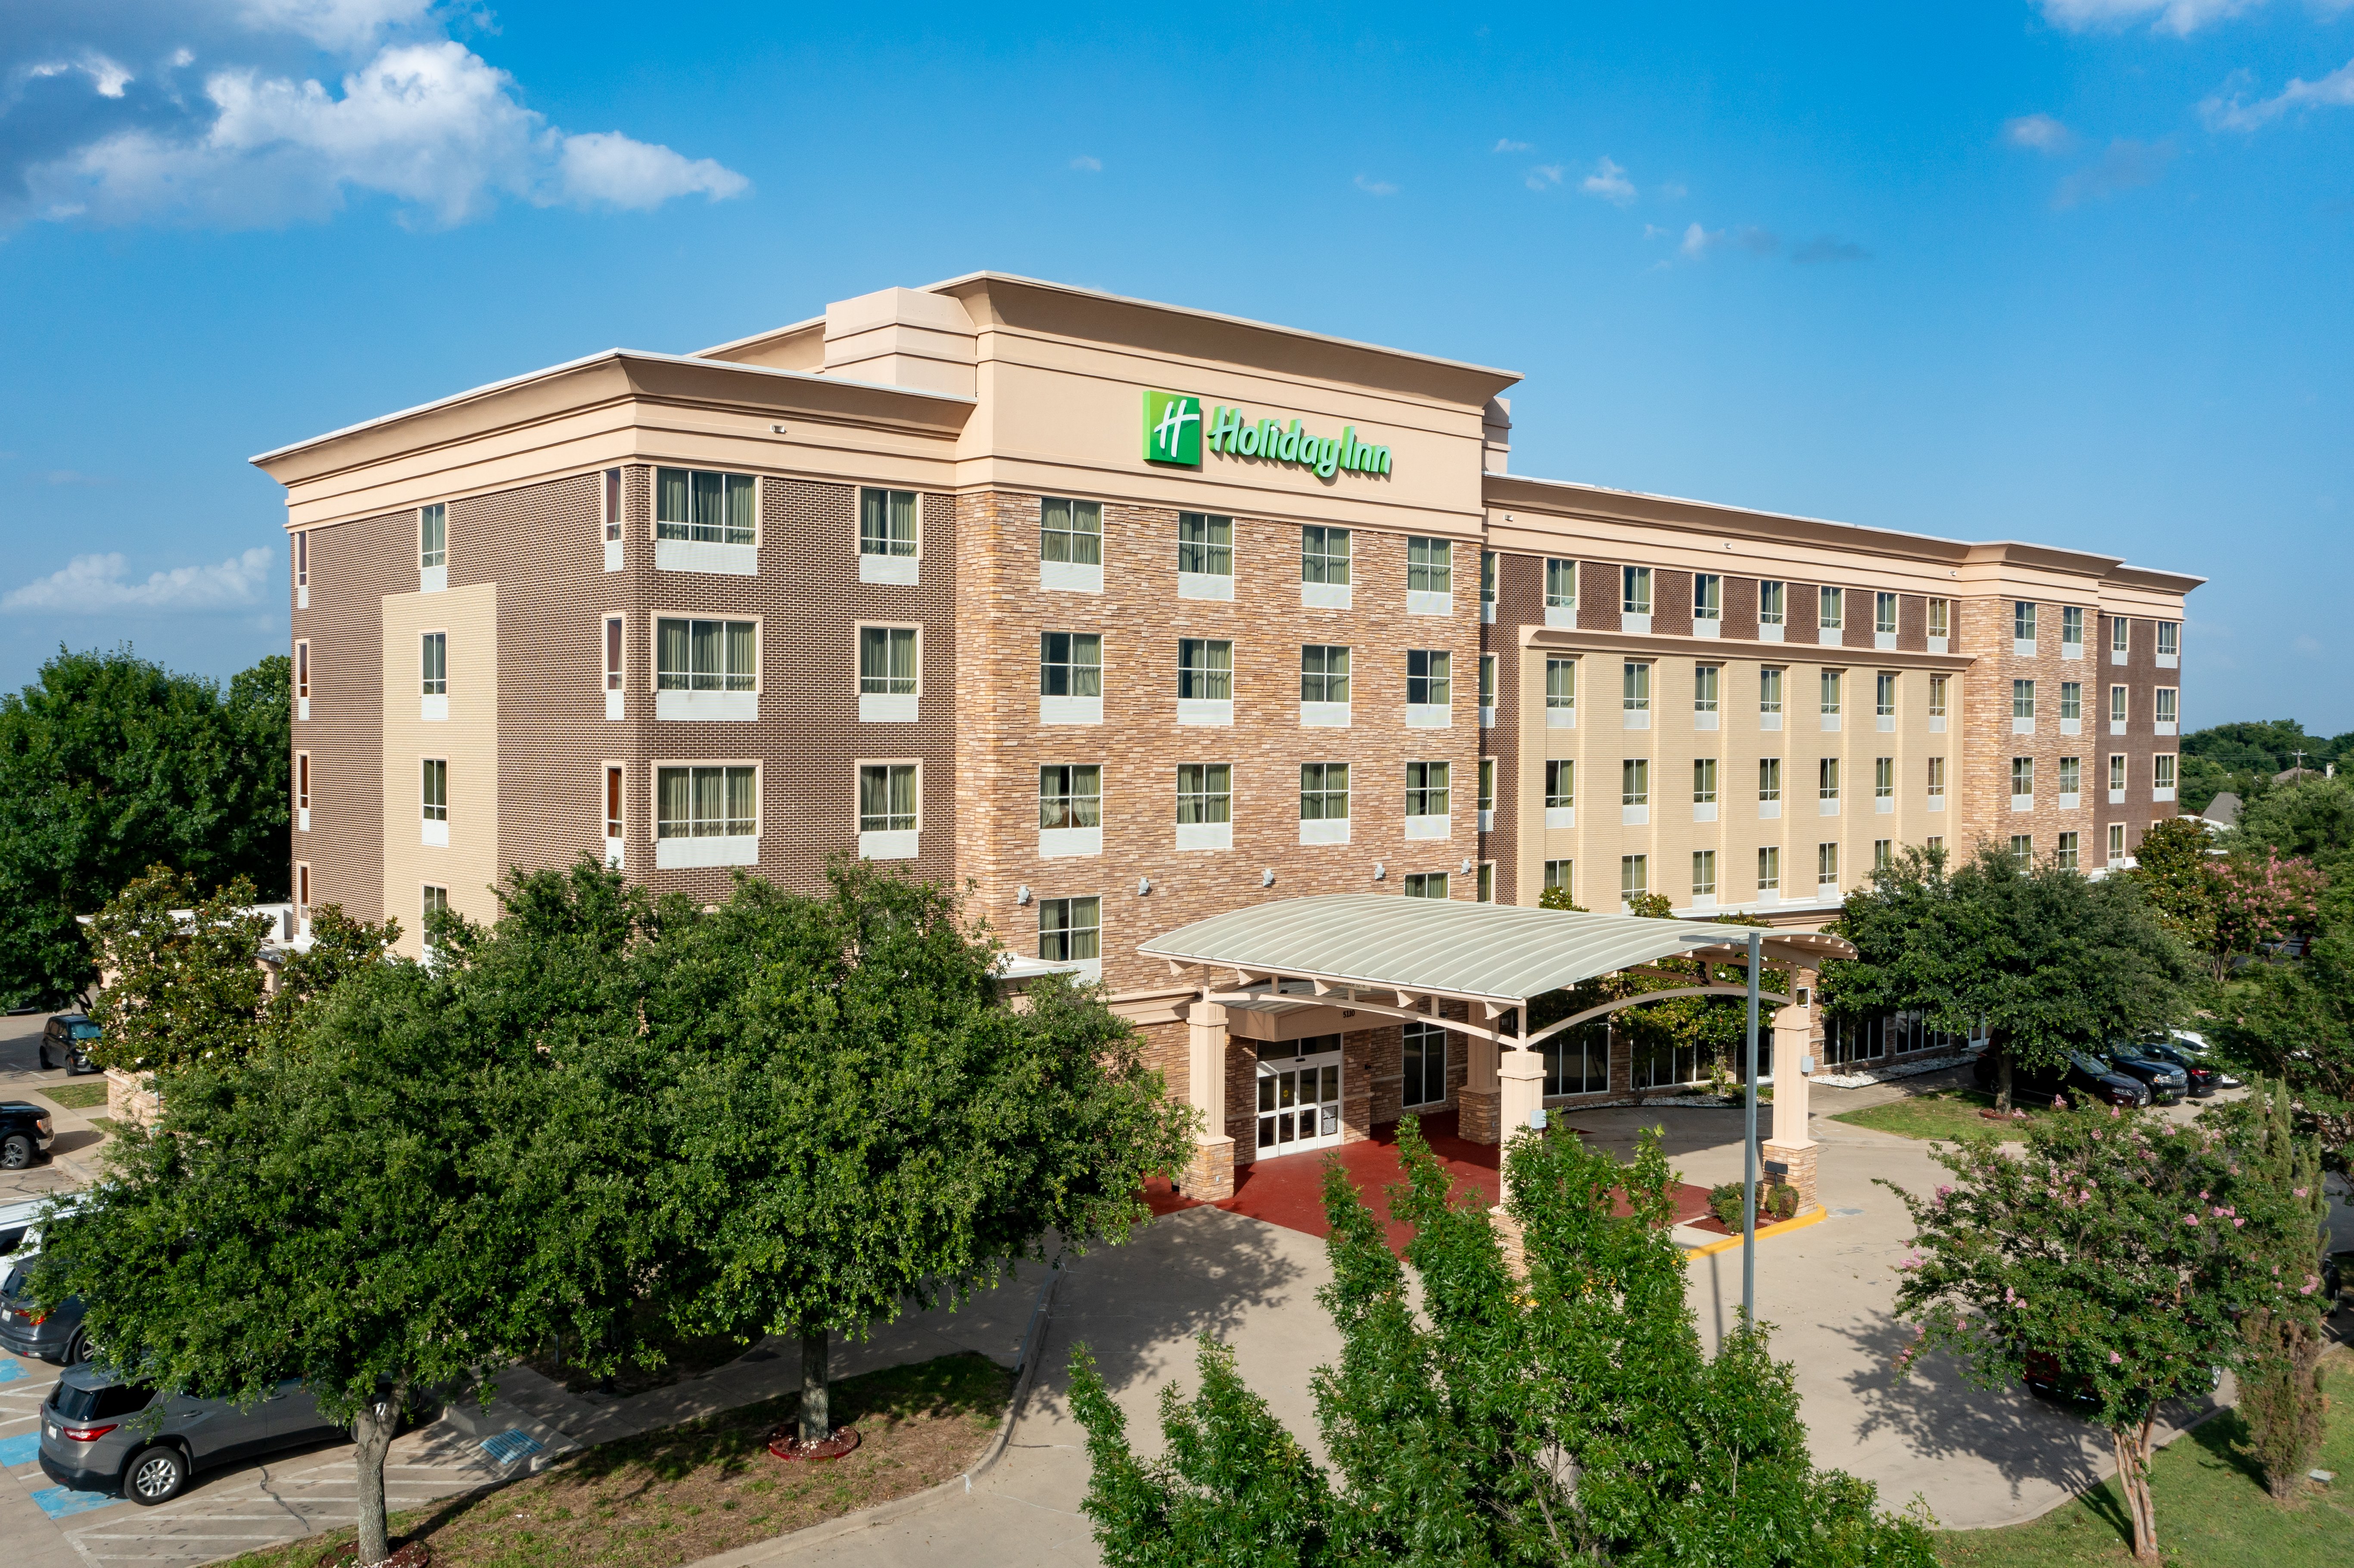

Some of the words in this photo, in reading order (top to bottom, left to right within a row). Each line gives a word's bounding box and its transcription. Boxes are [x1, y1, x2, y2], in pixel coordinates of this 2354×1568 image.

[1154, 399, 1200, 457] H
[1207, 406, 1340, 477] Holiday
[1340, 426, 1391, 474] Inn
[1343, 1010, 1355, 1018] 5110
